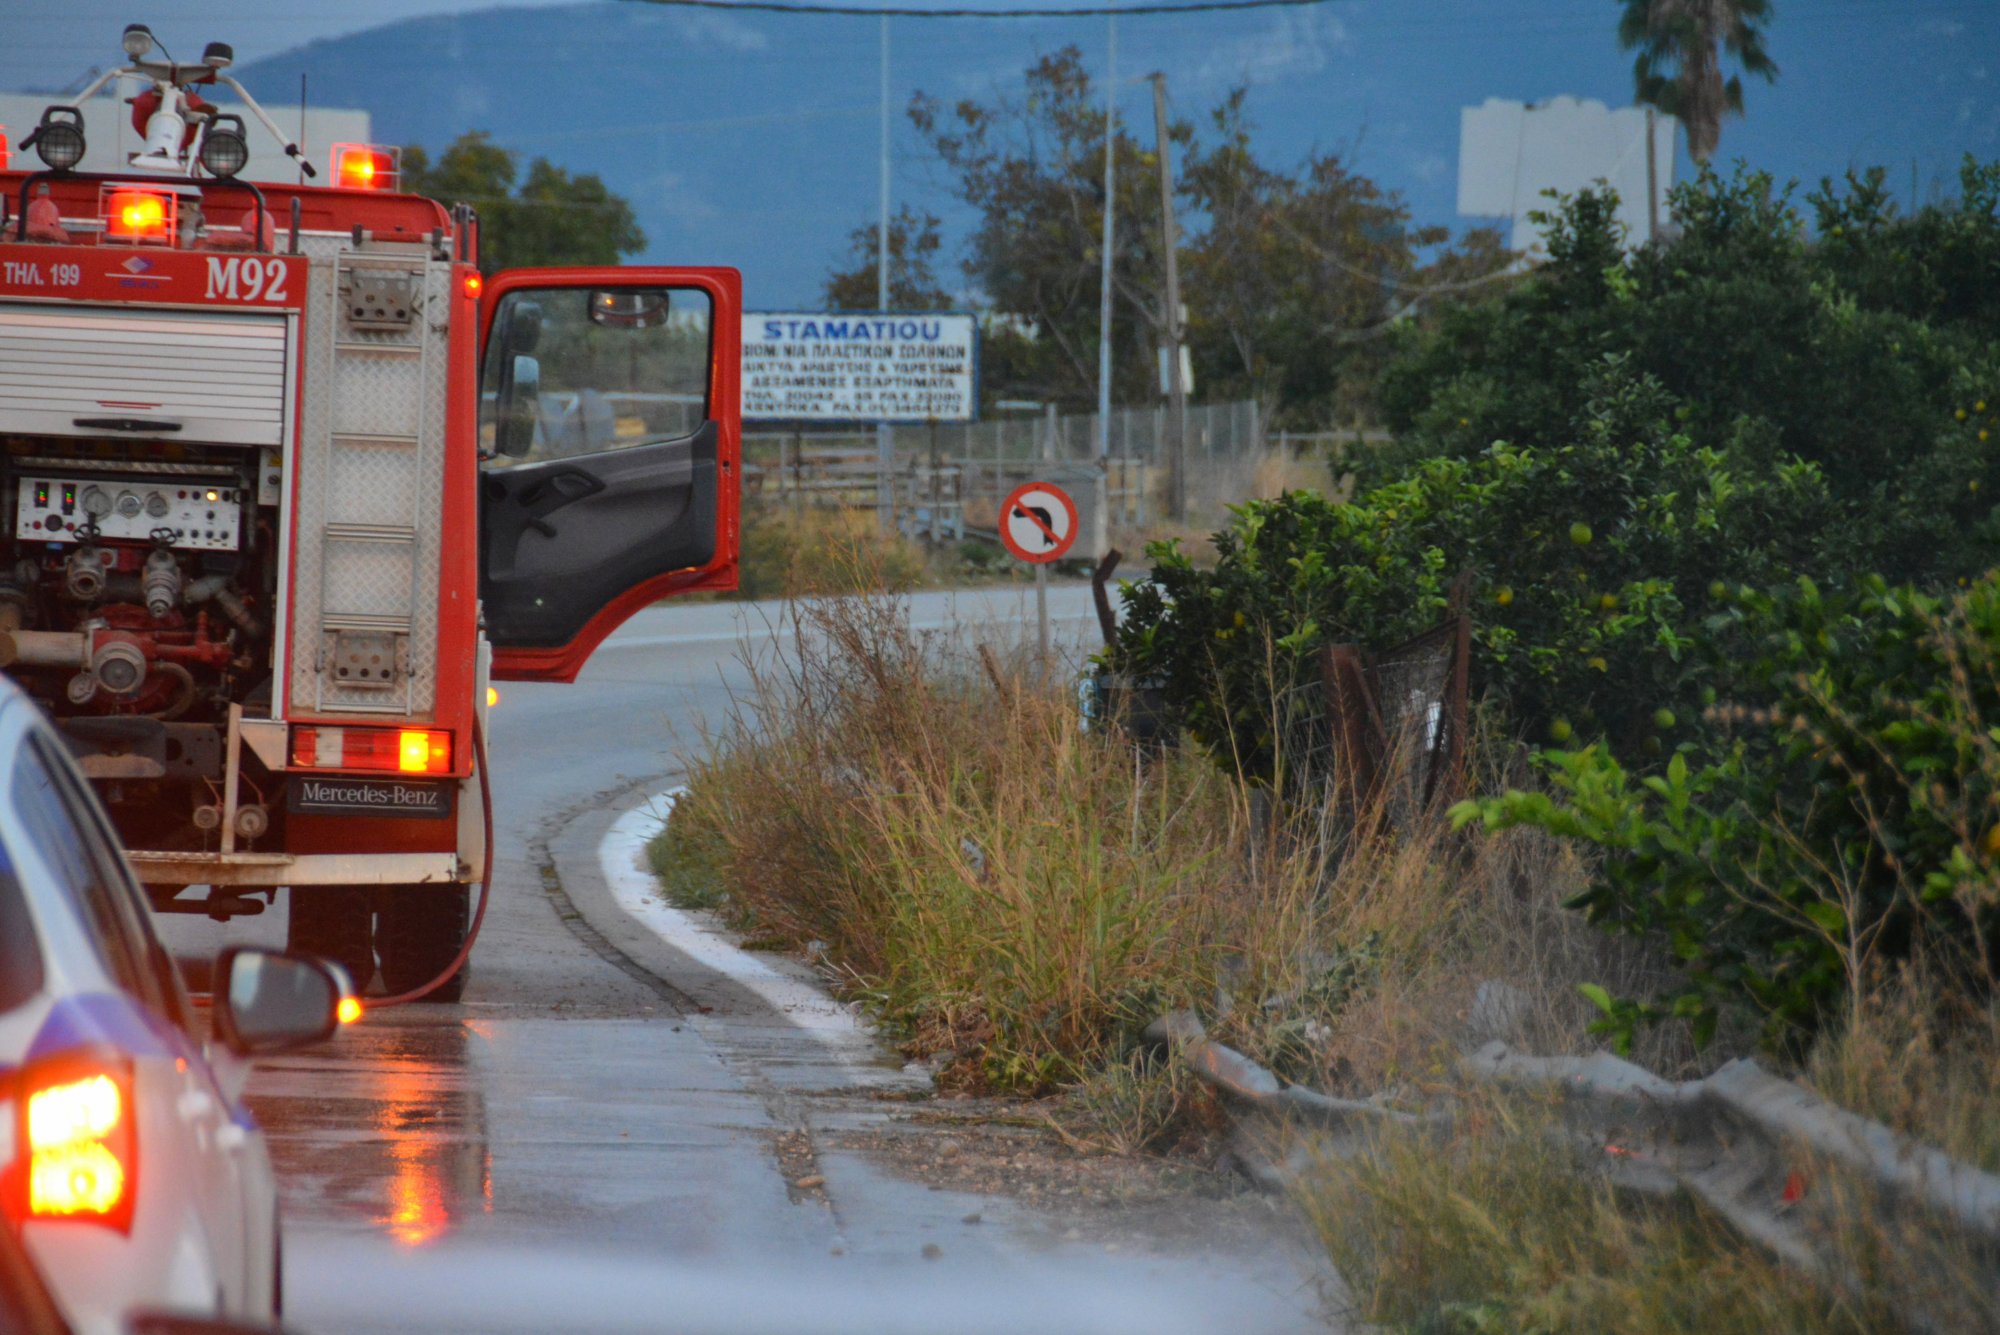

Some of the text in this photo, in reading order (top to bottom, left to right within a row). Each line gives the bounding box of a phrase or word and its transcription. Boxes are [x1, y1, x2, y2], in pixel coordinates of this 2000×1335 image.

[3, 262, 80, 286] ΤΗΛ. 199
[205, 256, 287, 301] M92
[763, 320, 941, 341] STAMATIOU
[303, 782, 438, 806] Mercedes-Benz
